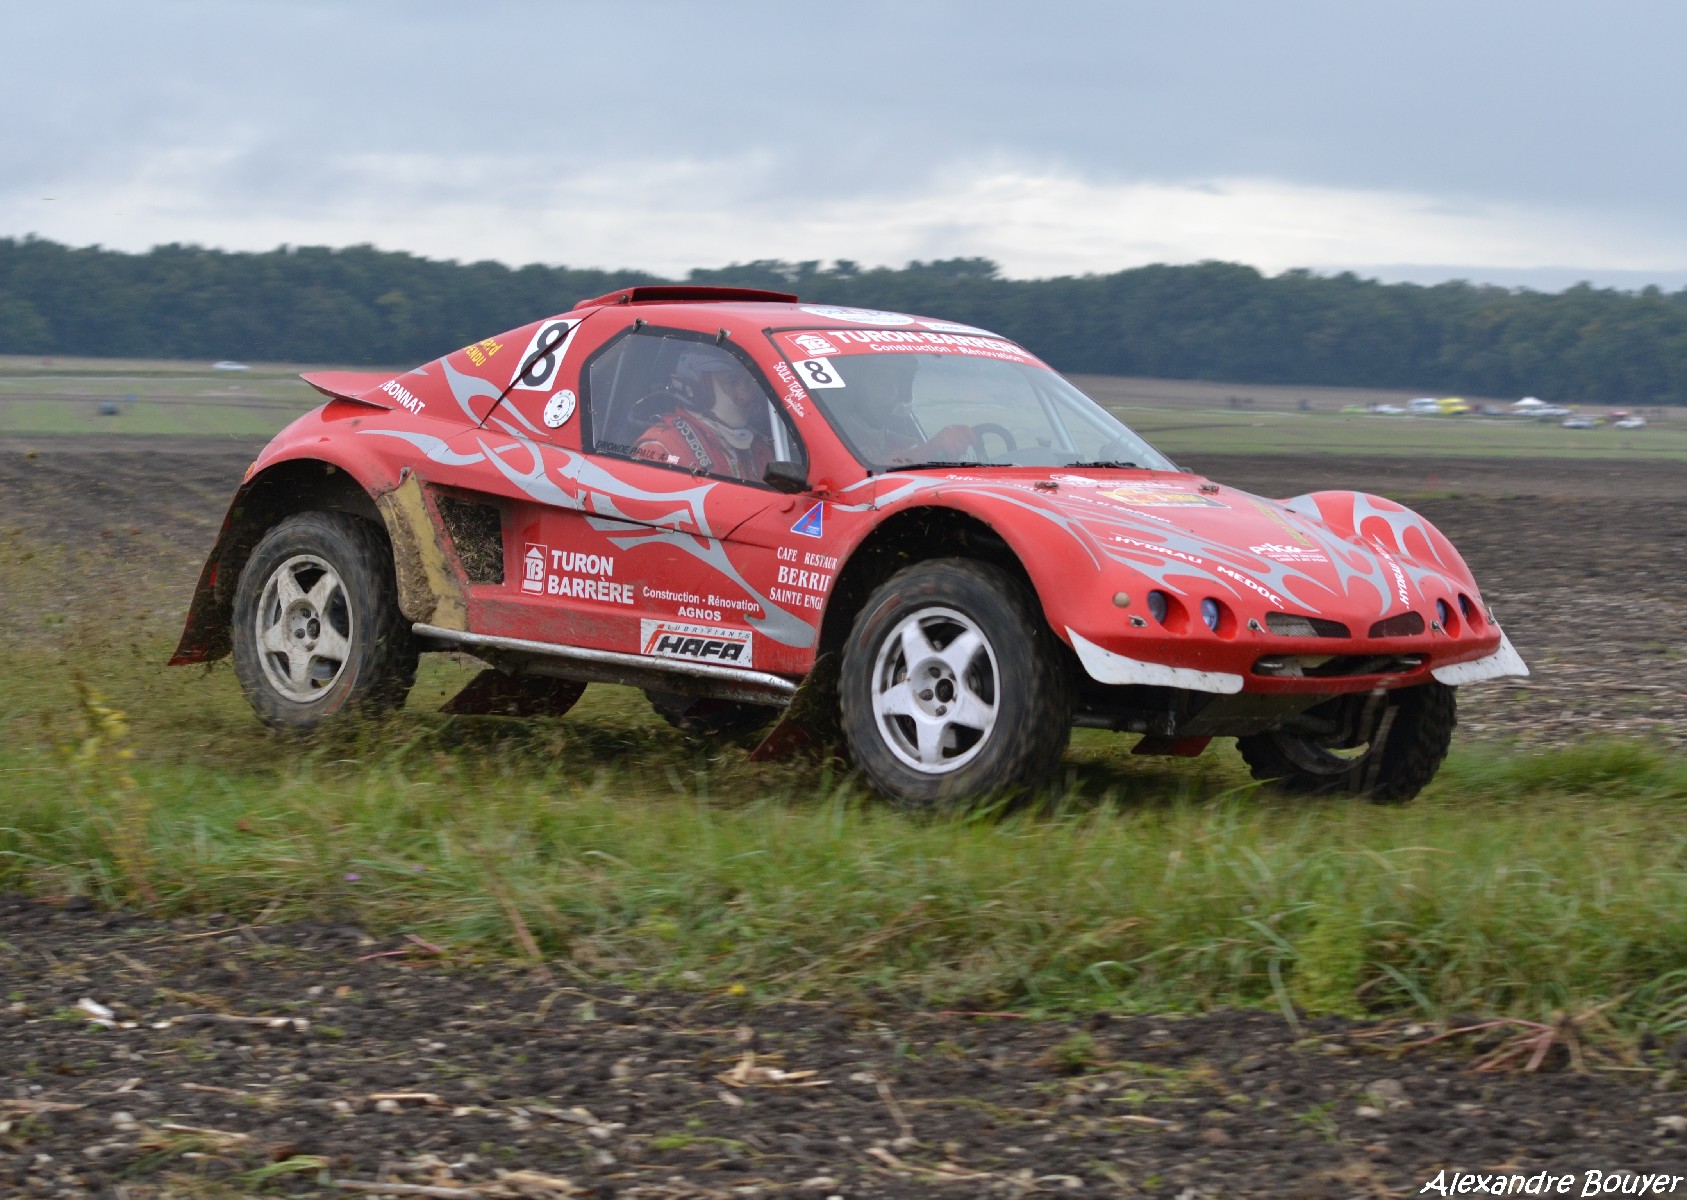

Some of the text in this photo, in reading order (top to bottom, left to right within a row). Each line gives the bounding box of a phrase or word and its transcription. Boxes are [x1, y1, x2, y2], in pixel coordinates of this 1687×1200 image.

[521, 322, 570, 387] 8
[869, 344, 951, 353] Construction
[773, 361, 807, 401] SOULE TEAM
[804, 361, 832, 384] 8
[551, 549, 614, 577] TURON
[777, 546, 798, 562] CAFE
[547, 574, 634, 605] BARRÈRE
[642, 586, 700, 604] Construction
[708, 594, 760, 612] Rénovation
[769, 587, 803, 606] SAINTE
[678, 606, 722, 621] AGNOS
[667, 625, 751, 639] LUBRIFIANTS
